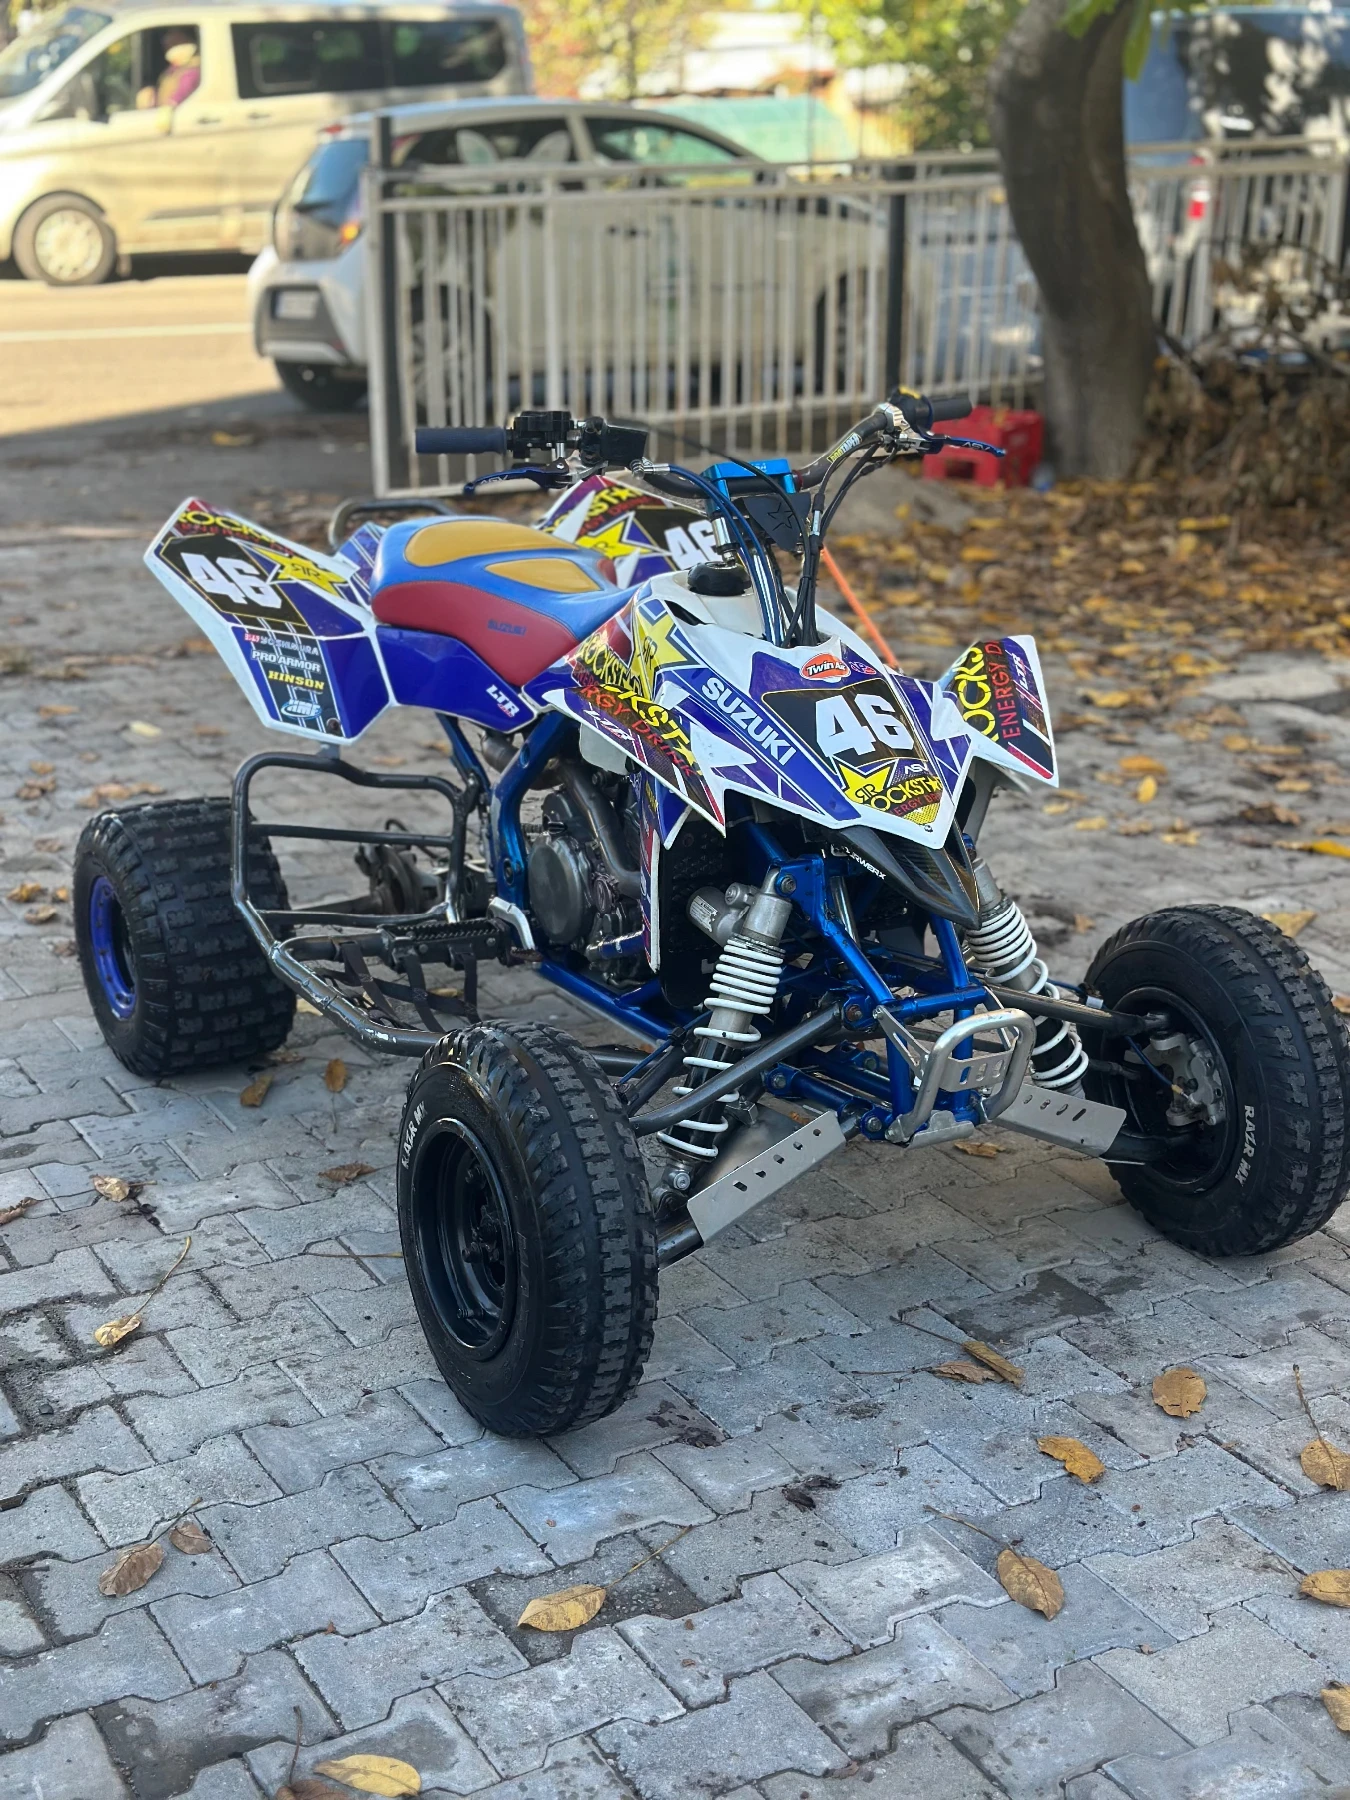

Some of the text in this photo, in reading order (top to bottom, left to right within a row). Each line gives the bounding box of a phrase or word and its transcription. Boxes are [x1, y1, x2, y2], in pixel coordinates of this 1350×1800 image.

[179, 552, 282, 609] 46
[251, 650, 321, 673] PRO ARMOR
[267, 670, 325, 690] HINSON
[806, 660, 835, 676] Twin
[835, 661, 847, 671] Air
[701, 677, 798, 766] SUZUKI
[815, 693, 915, 758] 46
[988, 661, 1022, 739] ENERGY
[904, 763, 930, 775] ASV
[1243, 1104, 1257, 1158] RAZR
